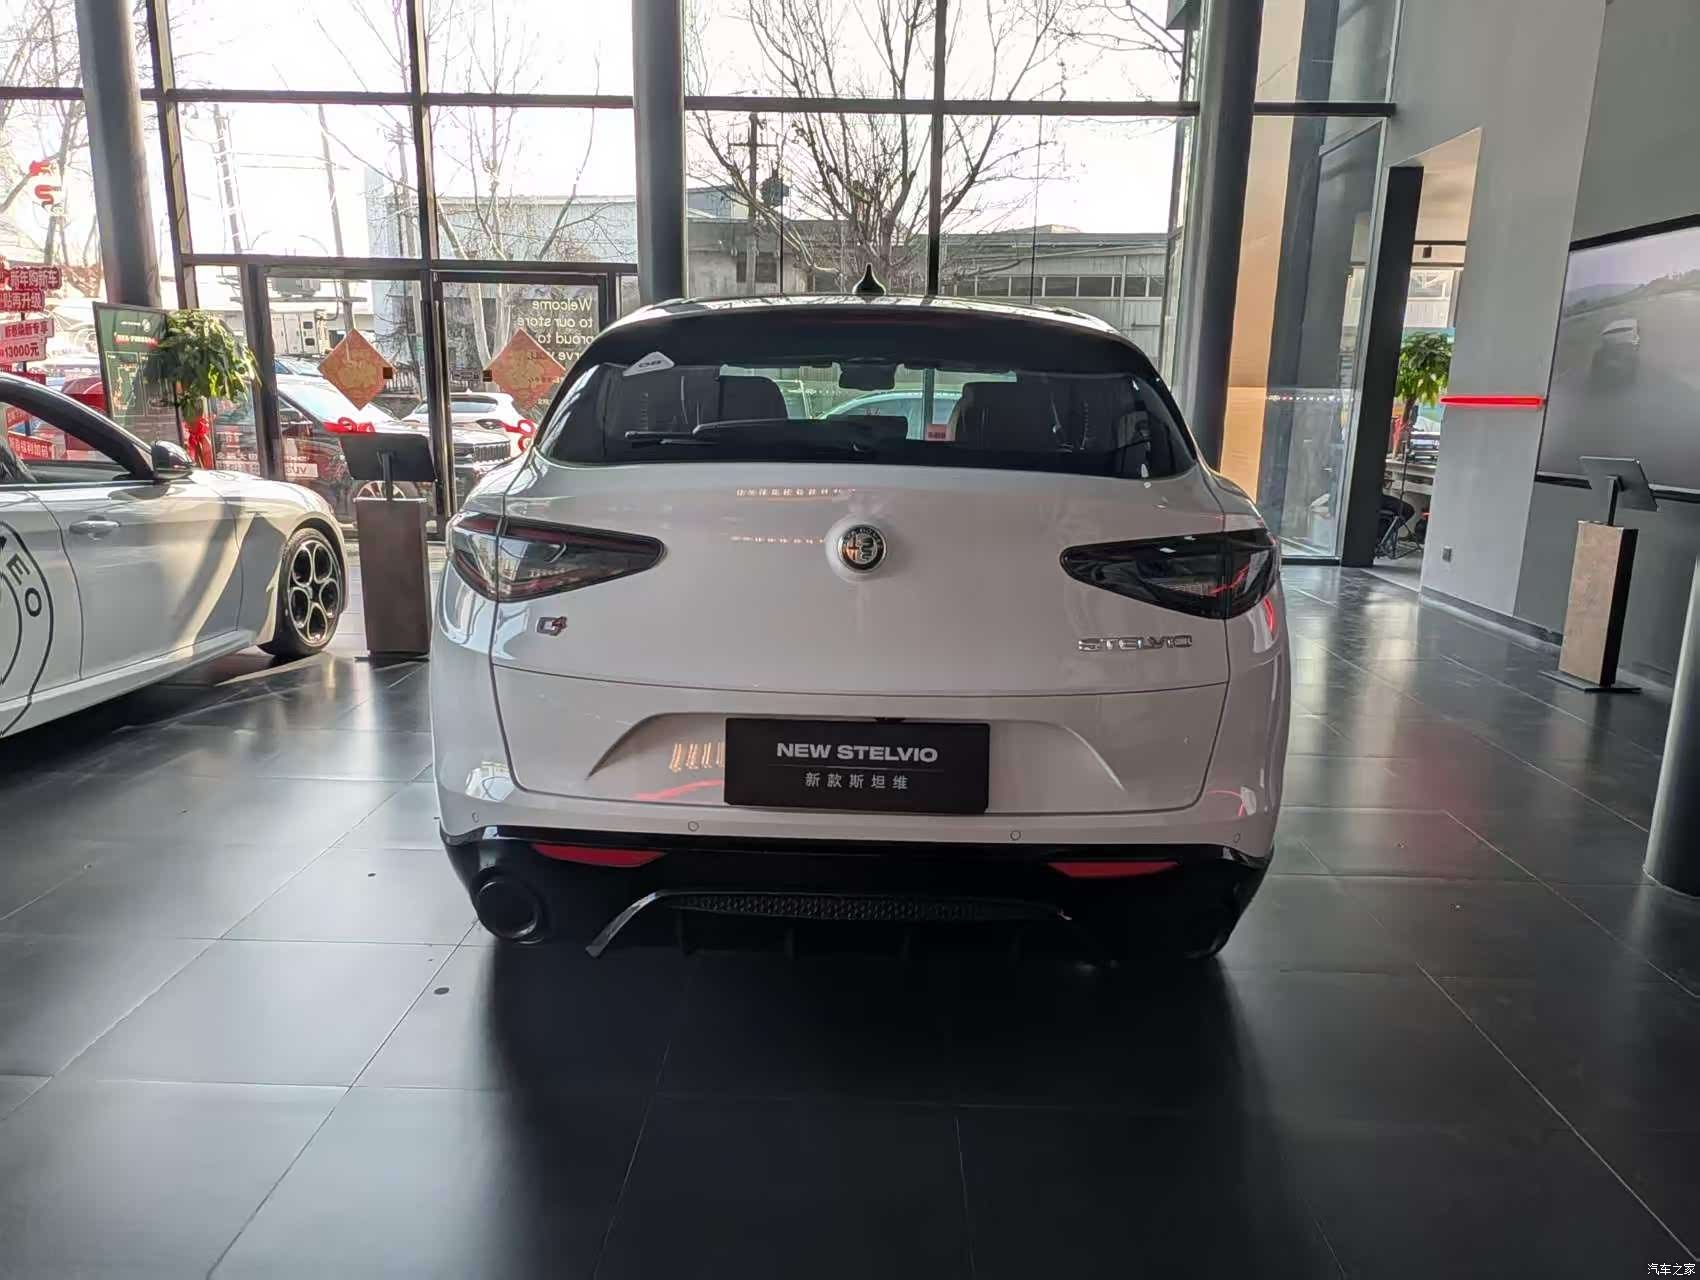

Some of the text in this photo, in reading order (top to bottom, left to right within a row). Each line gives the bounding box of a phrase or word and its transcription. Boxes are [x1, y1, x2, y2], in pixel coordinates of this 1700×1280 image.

[1078, 635, 1192, 651] STELVIO
[777, 743, 938, 762] NEW STELVIO
[805, 772, 909, 790] 新款斯坦维
